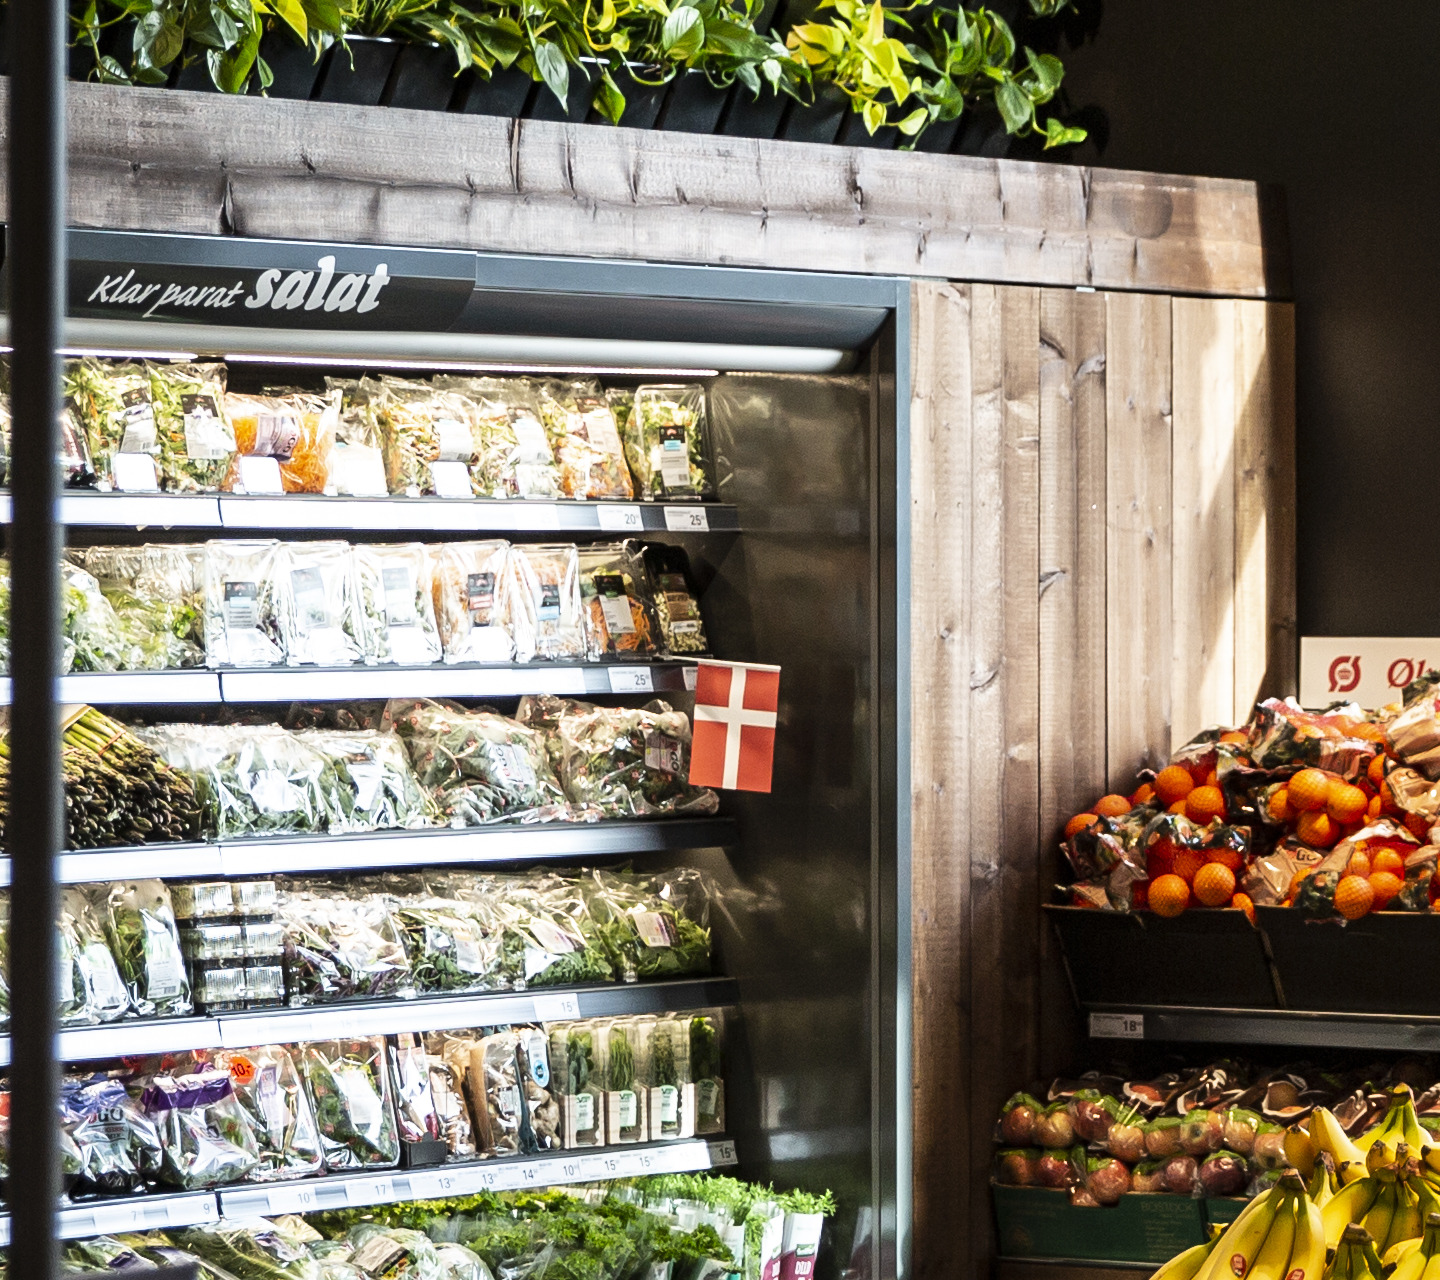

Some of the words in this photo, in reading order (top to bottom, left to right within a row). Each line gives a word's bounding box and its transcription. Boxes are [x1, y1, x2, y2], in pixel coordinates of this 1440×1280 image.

[87, 268, 157, 304] Klar
[142, 280, 245, 318] parat
[245, 255, 390, 313] salat
